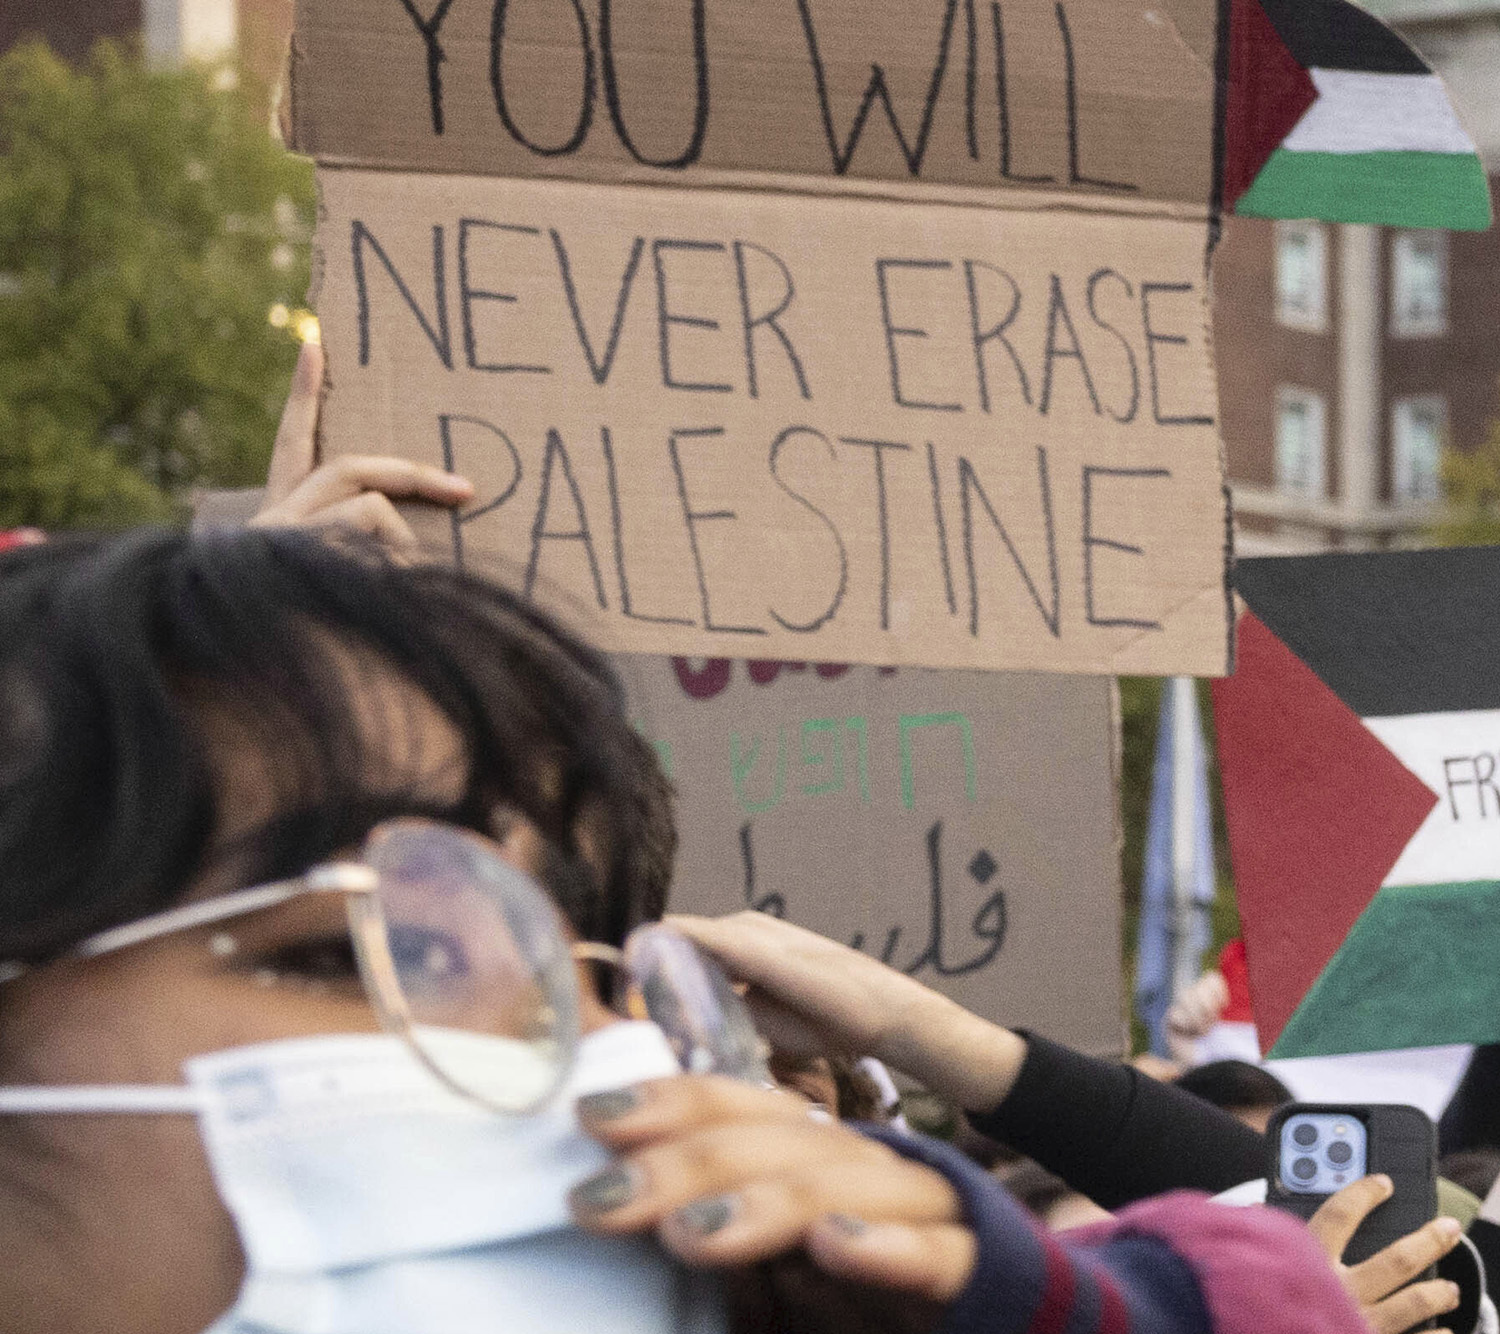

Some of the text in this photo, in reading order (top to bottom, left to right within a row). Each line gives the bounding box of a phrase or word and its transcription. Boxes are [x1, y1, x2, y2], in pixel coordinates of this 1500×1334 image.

[403, 0, 1139, 190] YOU WILL
[351, 218, 1214, 426] NEVER ERASE
[439, 414, 1171, 638] PALESTINE
